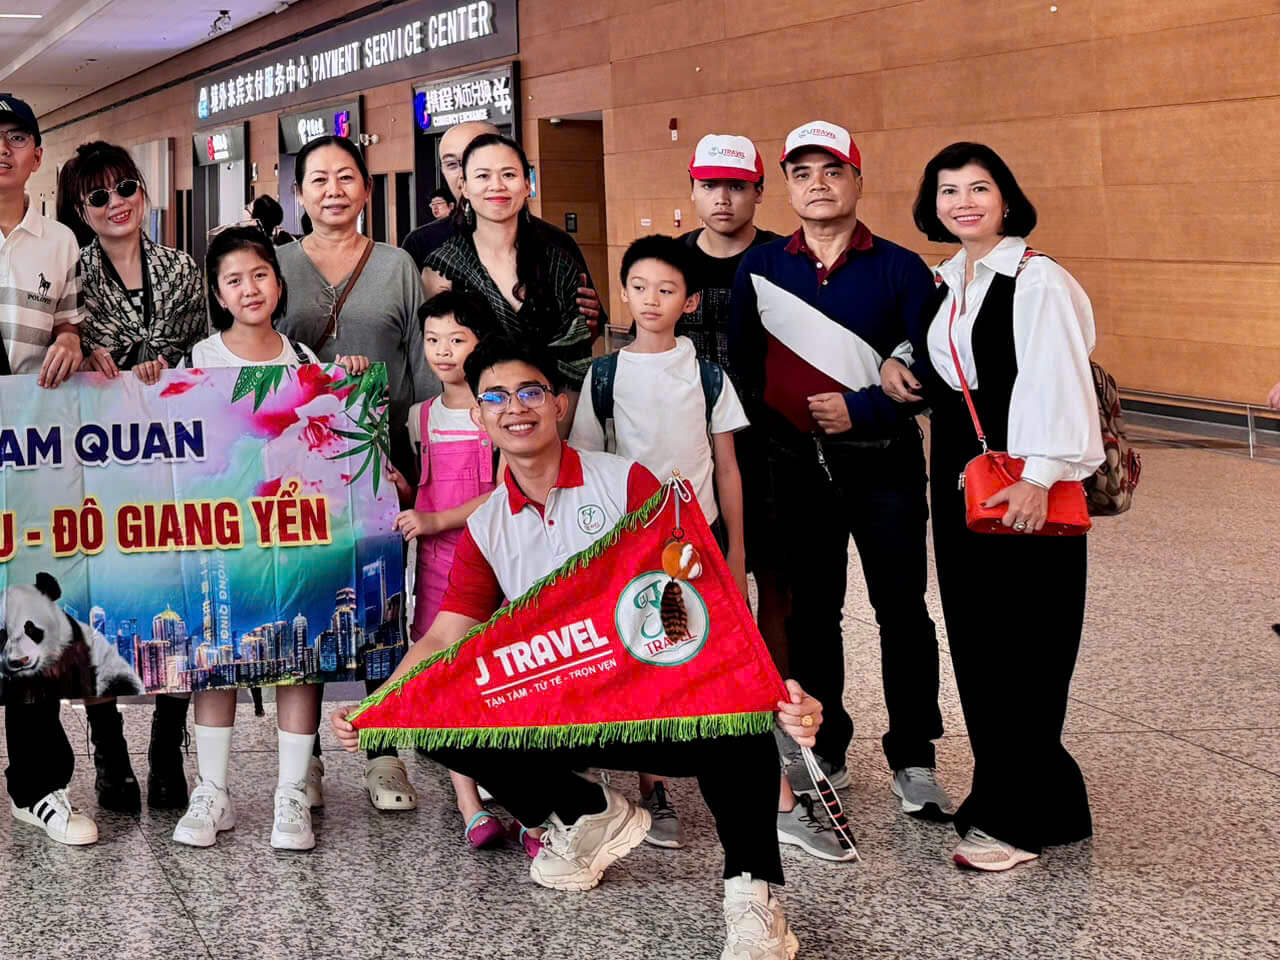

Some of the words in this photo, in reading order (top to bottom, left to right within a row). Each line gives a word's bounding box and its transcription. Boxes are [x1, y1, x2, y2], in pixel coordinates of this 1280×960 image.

[312, 41, 361, 83] PAYMENT
[365, 21, 424, 68] SERVICE
[428, 0, 494, 49] CENTER
[74, 420, 205, 465] QUAN
[53, 498, 104, 554] ĐÔ
[117, 501, 240, 550] GIANG
[251, 481, 328, 544] YỂN
[475, 660, 490, 687] J
[492, 617, 609, 679] TRAVEL
